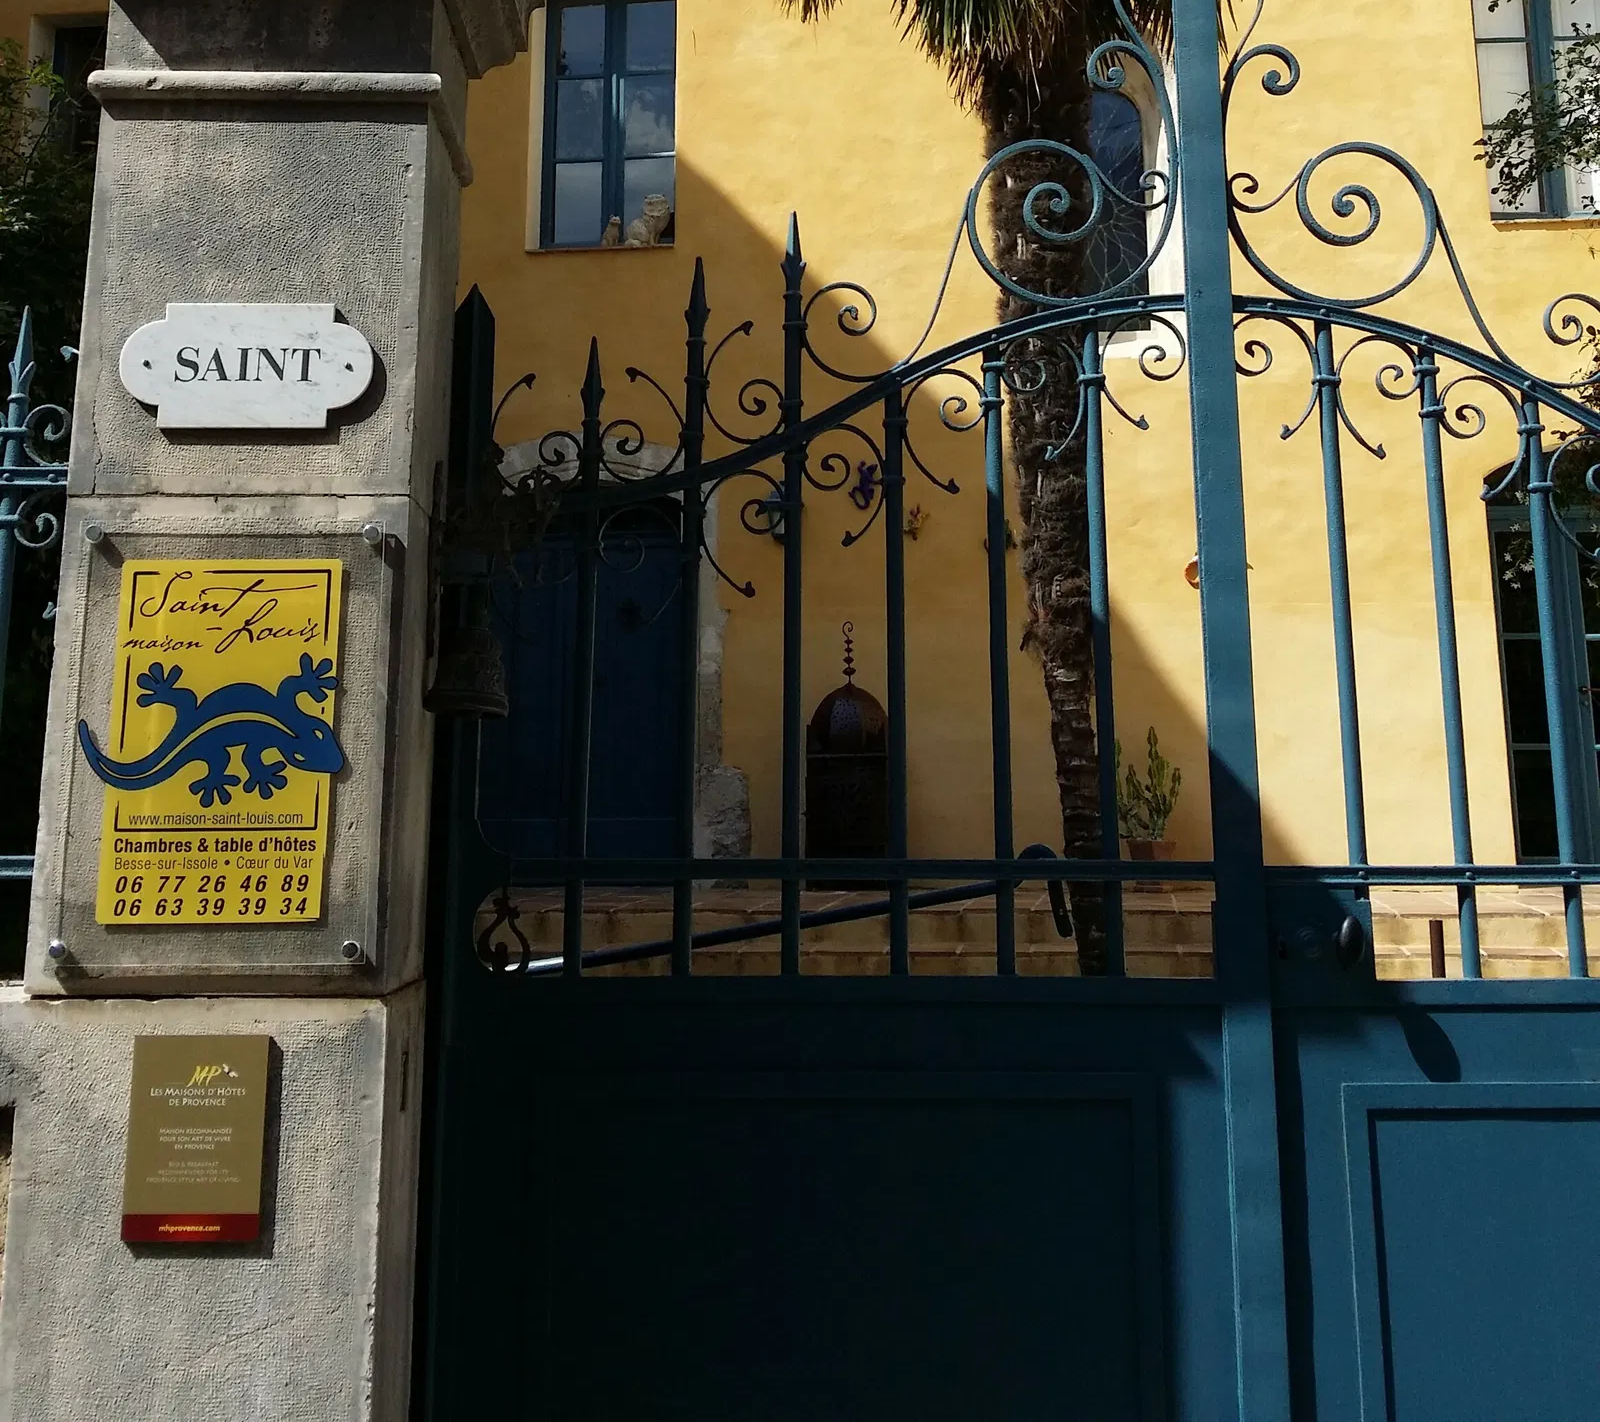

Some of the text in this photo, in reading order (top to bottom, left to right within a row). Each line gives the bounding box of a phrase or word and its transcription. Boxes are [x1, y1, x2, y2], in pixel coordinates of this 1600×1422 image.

[174, 346, 321, 382] SAINT
[140, 571, 317, 617] Saint
[121, 635, 203, 652] maison
[128, 812, 303, 826] www.maison-saint-louis.com
[114, 836, 316, 853] Chambres & table d'hôtes
[114, 856, 313, 870] Besse-sur-Issole Cœur du Var
[115, 874, 309, 893] 06 77 26 46 89
[113, 897, 308, 917] 06 63 39 39 34
[150, 1088, 163, 1096] LES
[164, 1087, 205, 1096] MAISONS
[169, 1097, 226, 1106] DE PROVENCE
[158, 1223, 221, 1233] mhprovence.com
